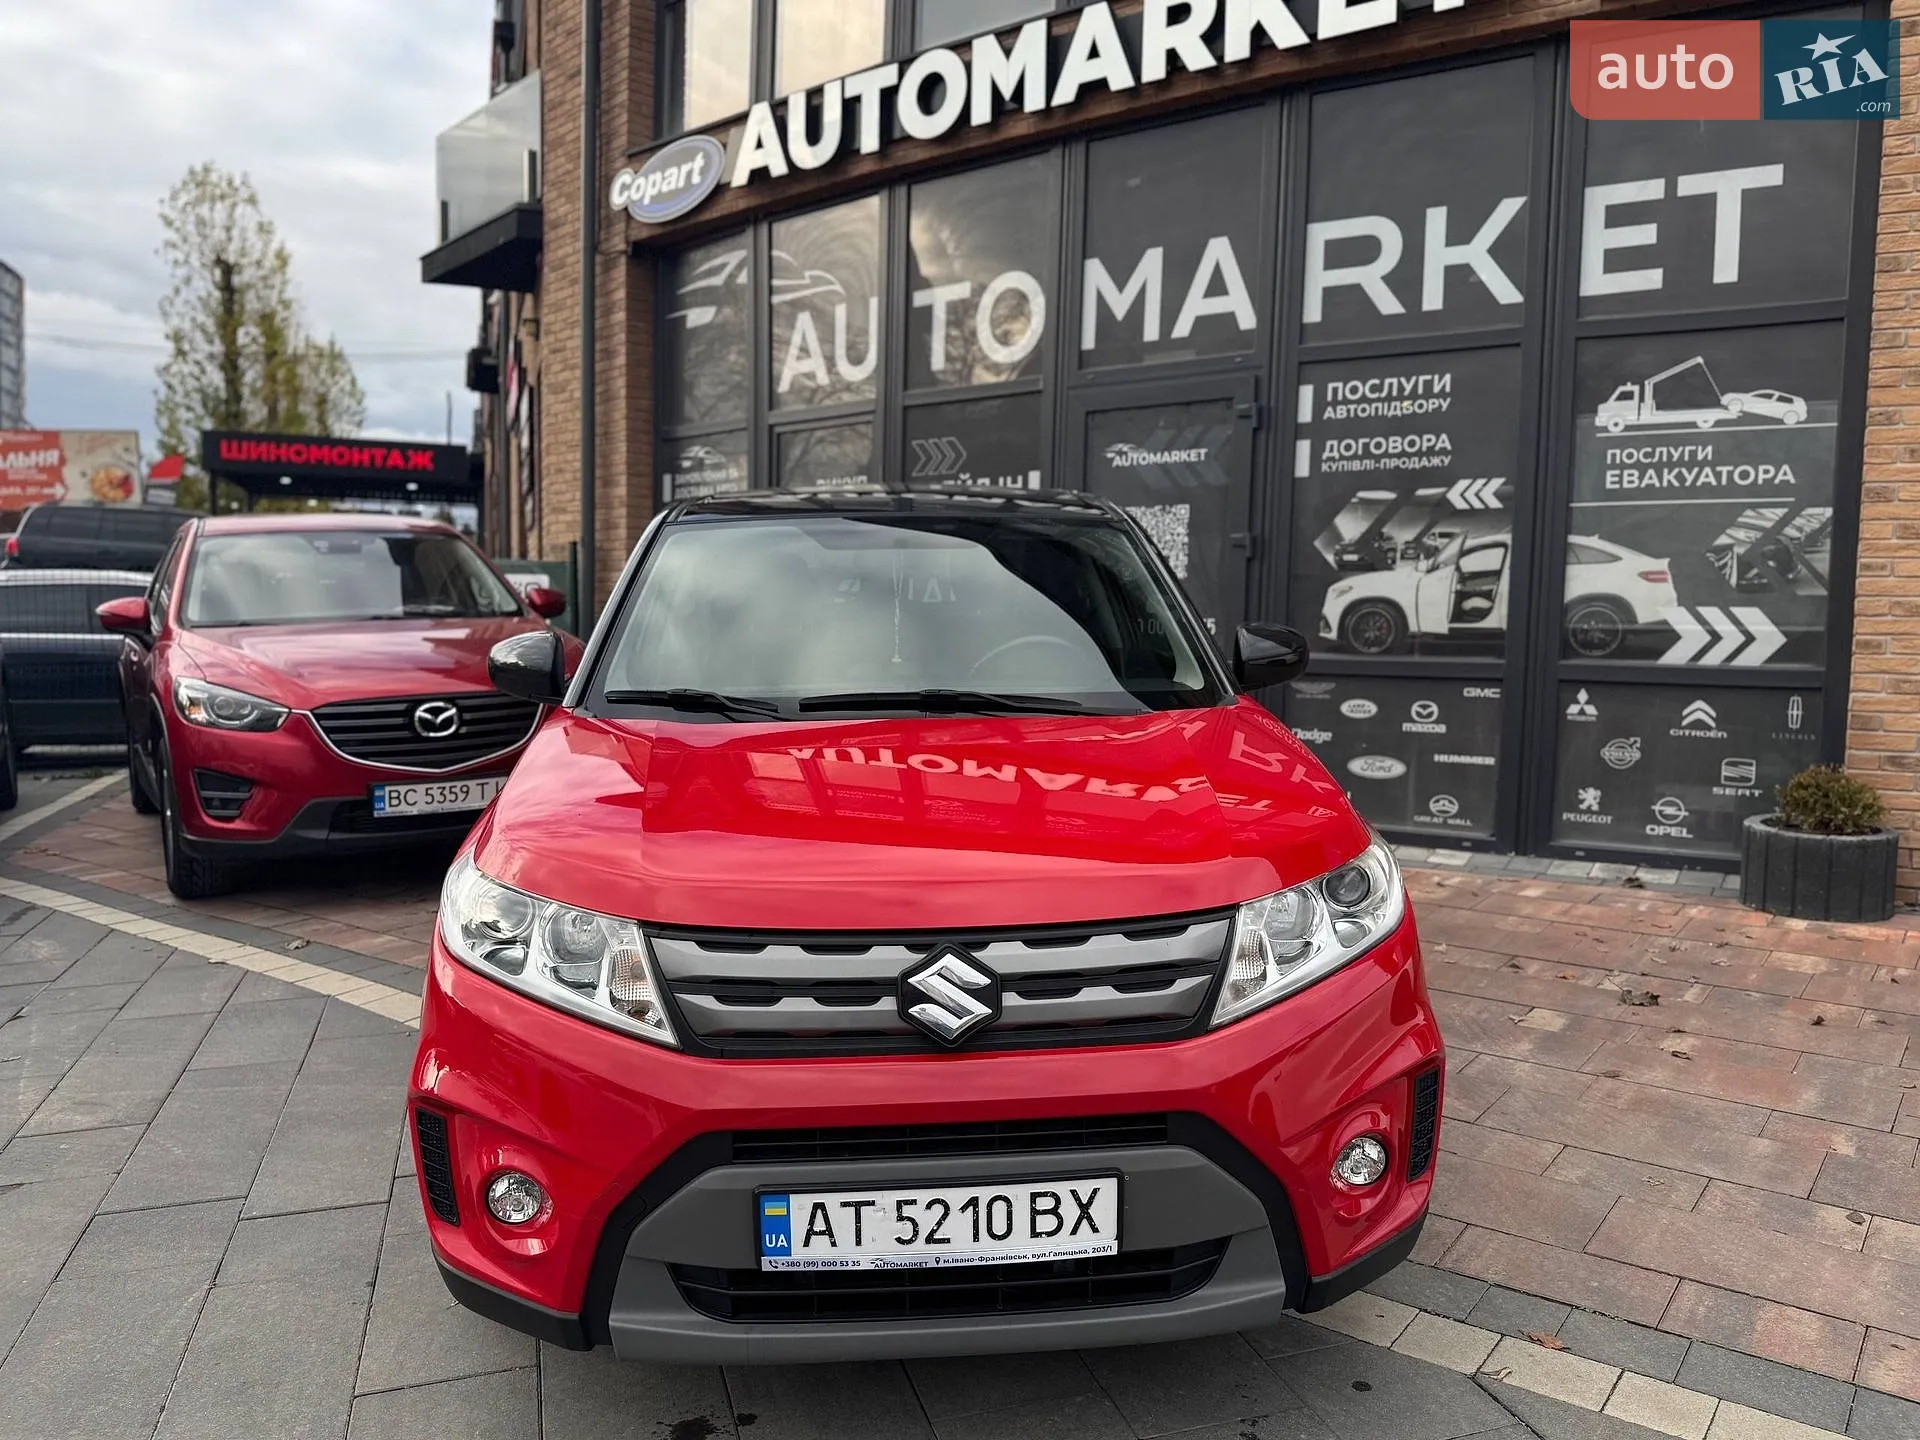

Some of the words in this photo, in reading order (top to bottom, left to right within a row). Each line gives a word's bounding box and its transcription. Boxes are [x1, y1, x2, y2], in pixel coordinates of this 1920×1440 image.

[730, 0, 1466, 188] AUTOMARK
[612, 151, 705, 206] Copart
[1326, 373, 1452, 402] ПОСЛУГИ
[1322, 397, 1452, 420] АВТОПІДБОРУ
[1321, 433, 1453, 460] ДОГОВОРА
[1606, 445, 1713, 464] ПОСЛУГИ
[219, 439, 435, 472] ШИНОМОНТАЖ
[1111, 448, 1209, 468] AUTOMARKET
[1320, 456, 1452, 473] КУПІВЛІ-ПРОДАЖУ
[1605, 464, 1797, 489] ЕВАКУАТОРА
[1463, 687, 1501, 698] GMC
[1359, 758, 1394, 774] Ford
[1433, 753, 1496, 766] HUMMER
[388, 788, 418, 808] BC
[424, 784, 471, 805] 5359
[1712, 787, 1764, 797] SEAT
[1413, 815, 1445, 825] GREAT
[1447, 816, 1473, 826] WALL
[1562, 812, 1614, 824] PEUGEOT
[1645, 824, 1694, 838] OPEL
[802, 1199, 876, 1248] AT
[894, 1194, 1014, 1245] 5210
[1029, 1187, 1101, 1239] BX
[765, 1234, 788, 1248] UA
[1091, 1245, 1113, 1254] 203/1
[781, 1260, 801, 1268] +380
[803, 1260, 819, 1268] (99)
[874, 1261, 929, 1269] AUTOMARKET
